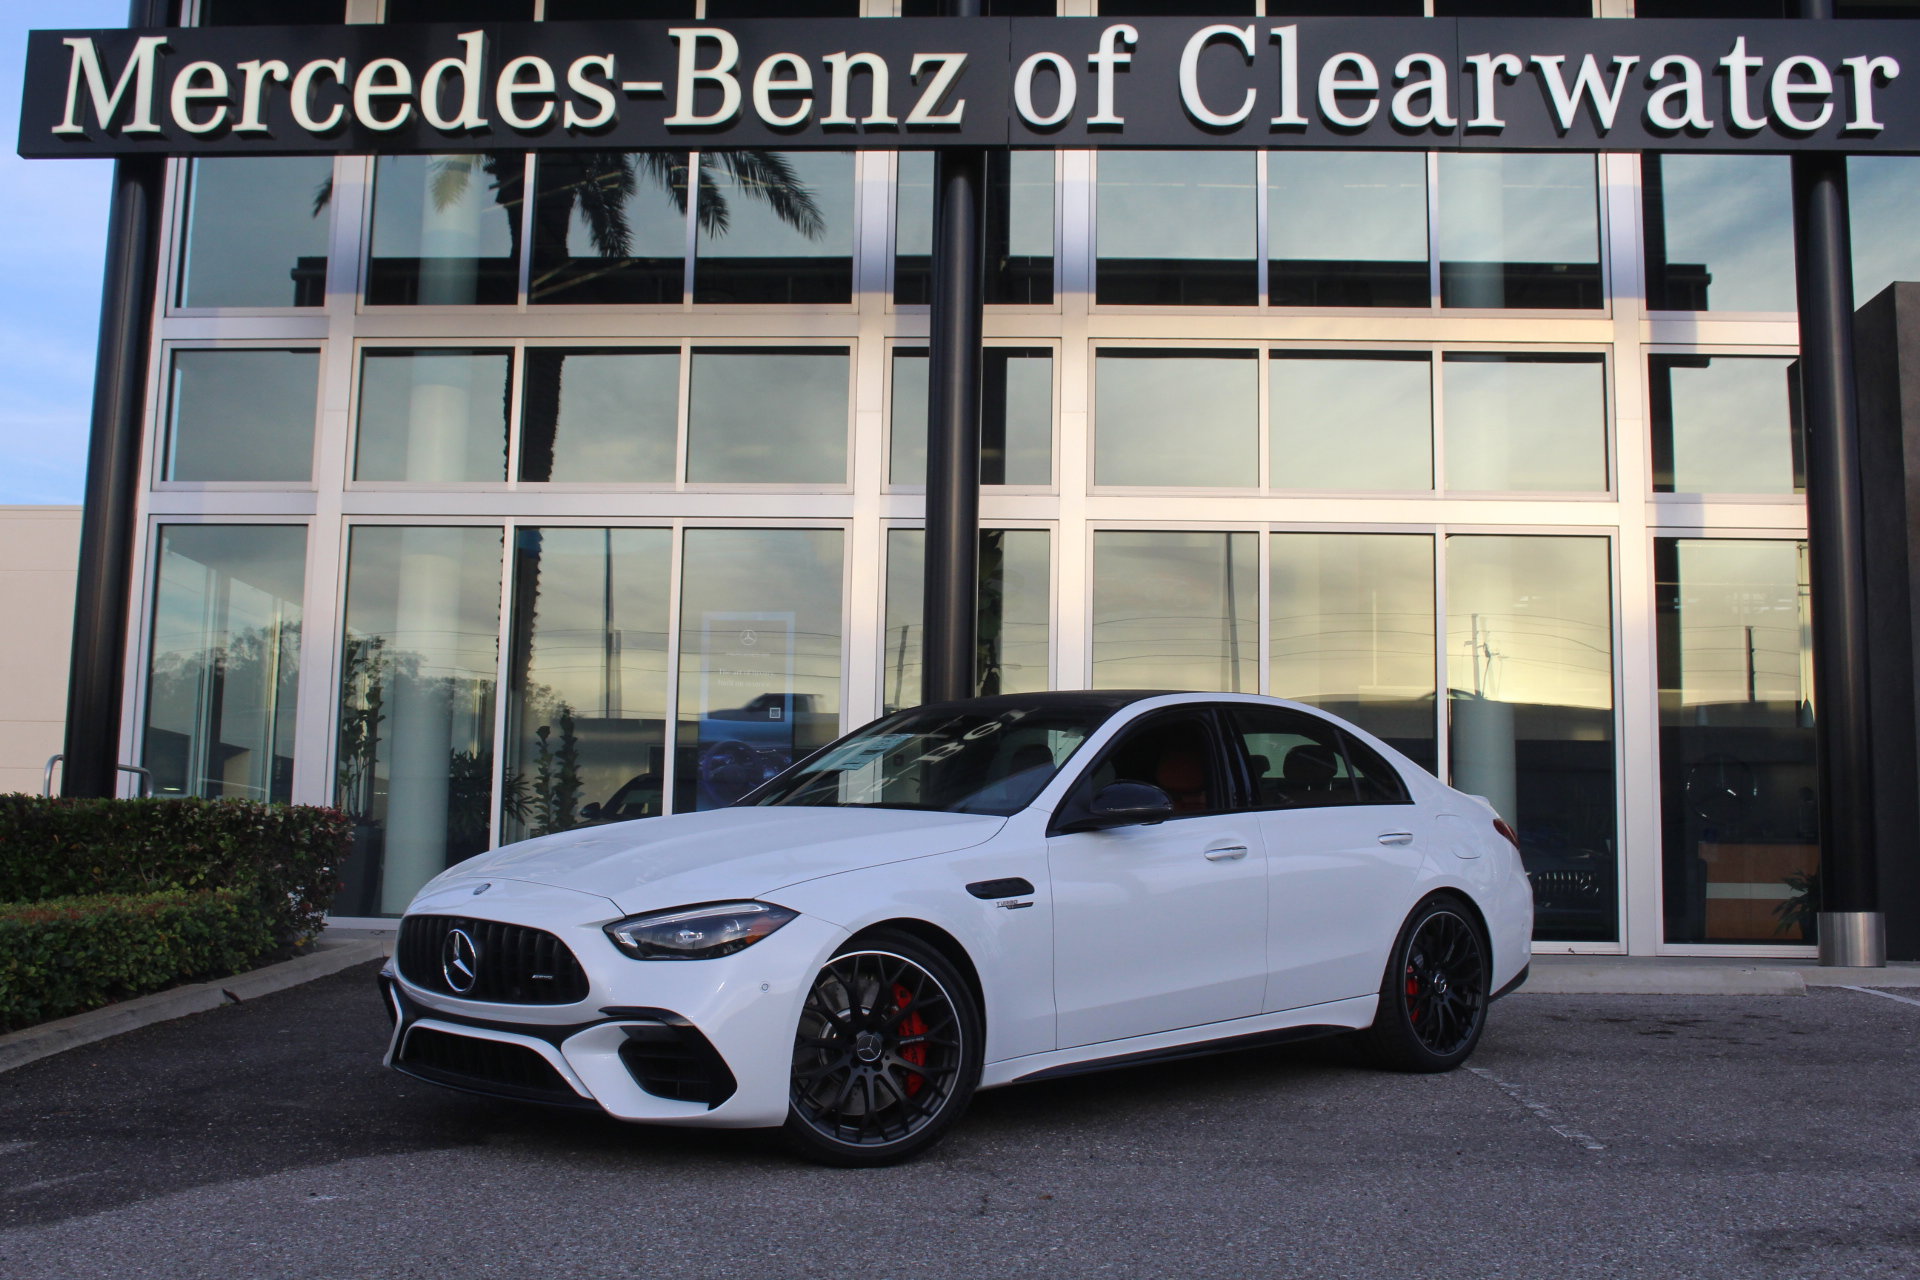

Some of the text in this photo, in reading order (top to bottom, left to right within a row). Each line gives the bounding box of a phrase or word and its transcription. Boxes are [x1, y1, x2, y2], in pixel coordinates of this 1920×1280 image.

[51, 24, 1900, 133] Mercedes-Benz of Clearwater
